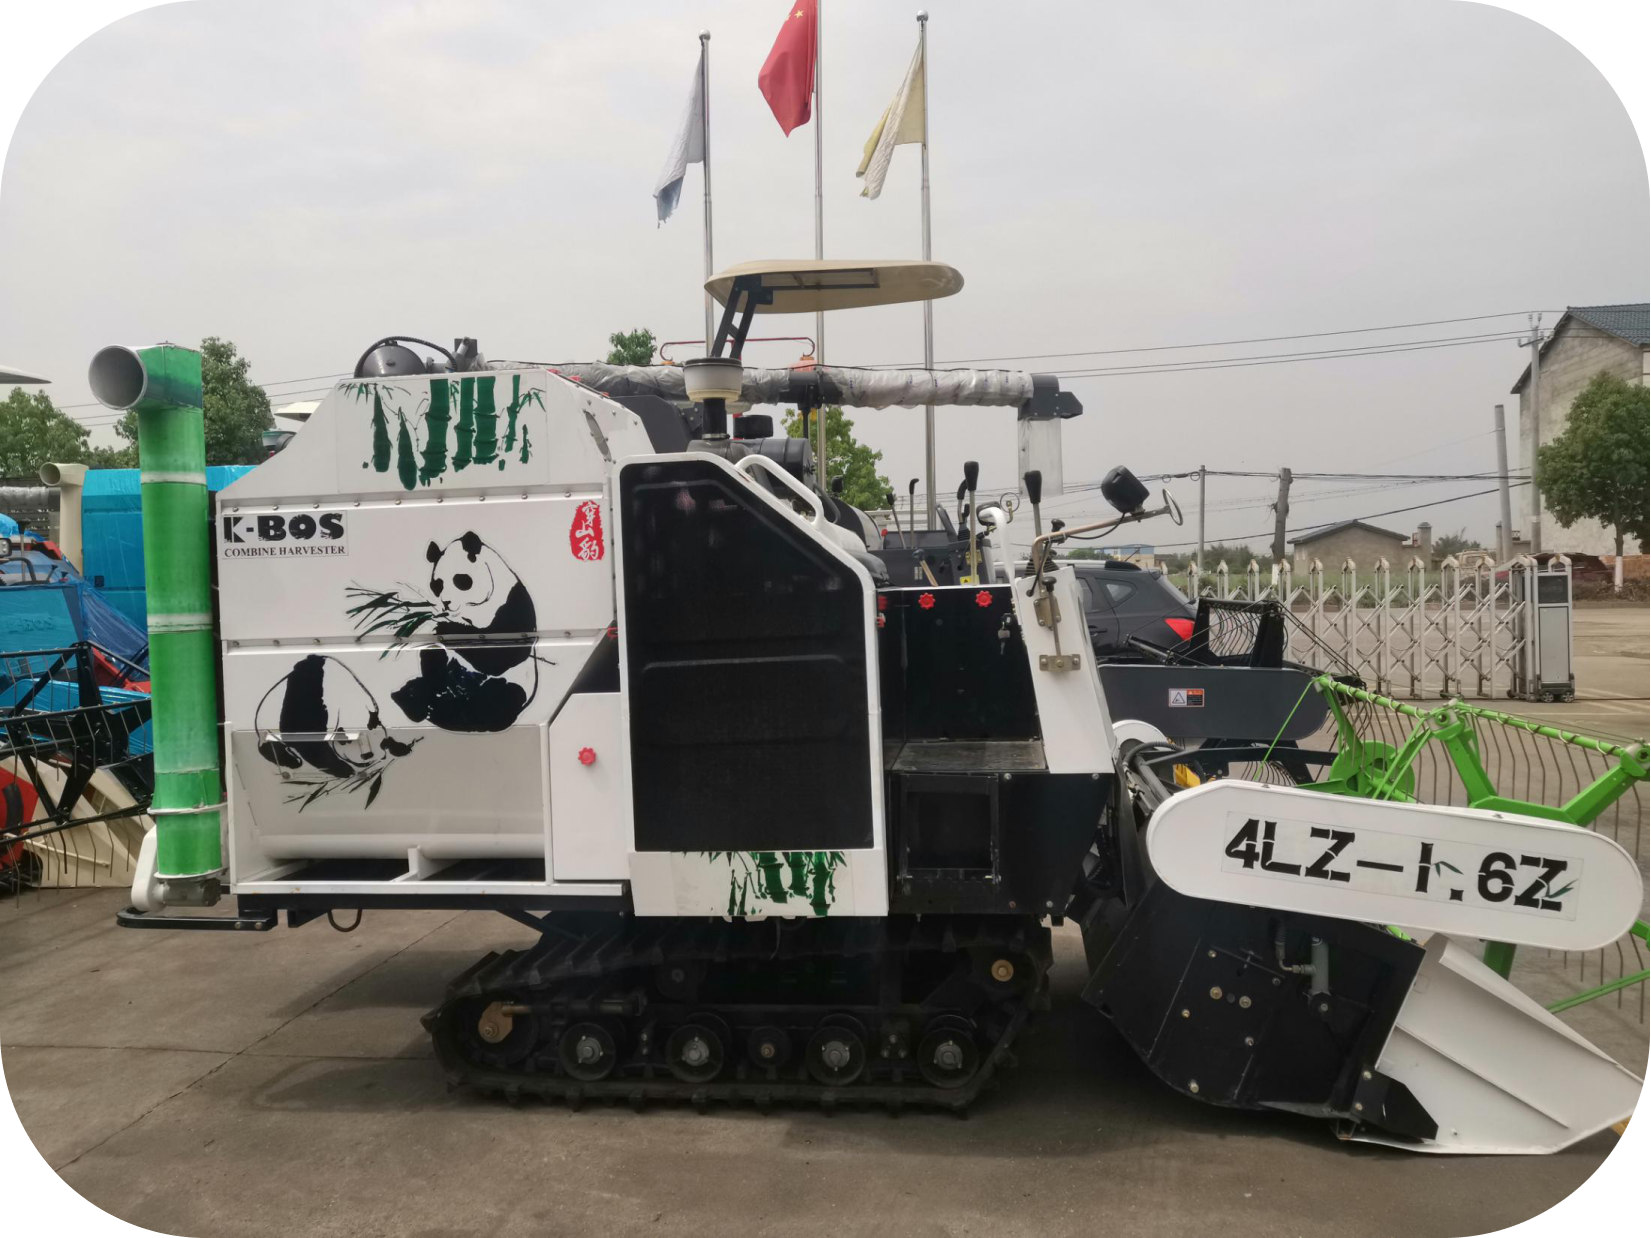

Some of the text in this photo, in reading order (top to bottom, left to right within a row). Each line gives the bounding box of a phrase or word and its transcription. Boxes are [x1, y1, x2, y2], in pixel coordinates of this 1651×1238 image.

[223, 513, 344, 543] K-BOS
[224, 545, 345, 558] COMBINE HARVESTER
